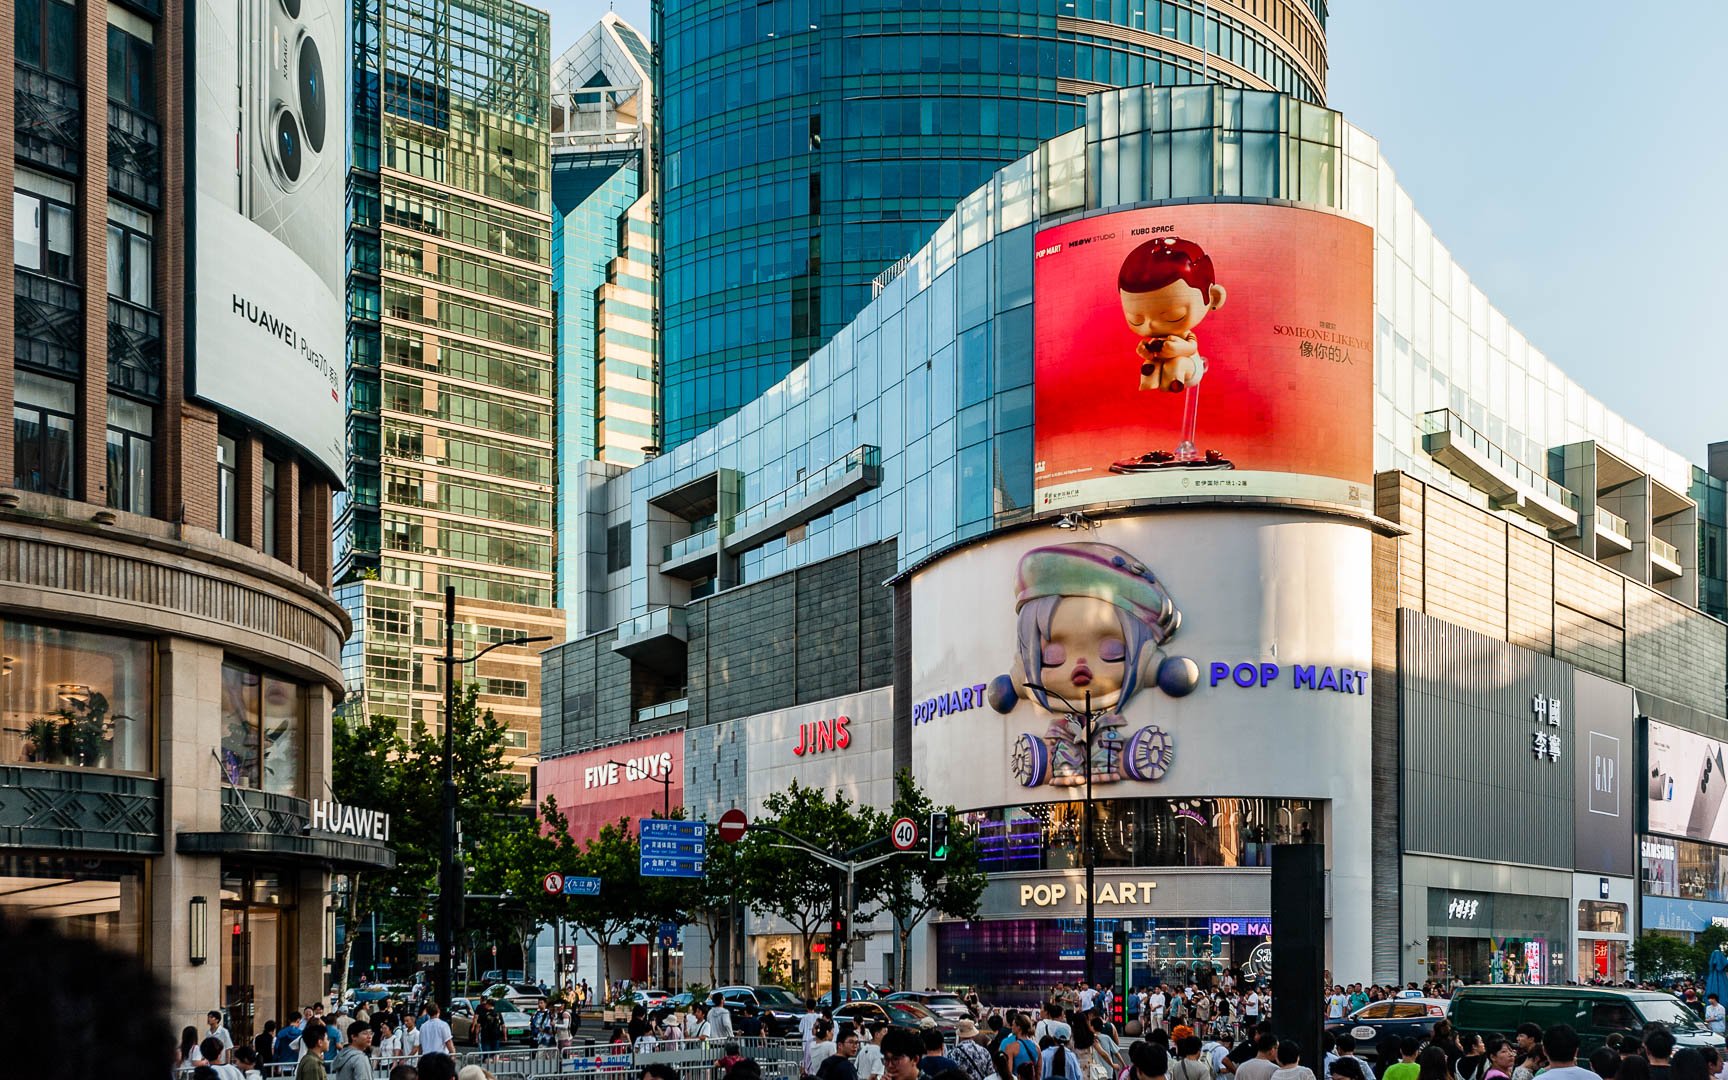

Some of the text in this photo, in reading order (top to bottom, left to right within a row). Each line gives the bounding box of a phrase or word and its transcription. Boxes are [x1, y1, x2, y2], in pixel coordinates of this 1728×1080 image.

[1092, 233, 1116, 243] STUDIO
[1131, 225, 1175, 236] KUBO SPACE
[1036, 244, 1062, 259] POP MART
[232, 294, 297, 350] HUAWEI
[1273, 325, 1330, 342] SOMEONE
[1331, 332, 1355, 348] LIKE
[1300, 340, 1354, 366] 像你的人
[1210, 662, 1369, 696] POP MART
[913, 684, 987, 727] POP MART
[585, 752, 672, 790] FIVE GUYS
[1595, 754, 1614, 794] GAP
[313, 798, 390, 842] HUAWEI
[897, 825, 913, 842] 40
[1642, 841, 1675, 861] SAMSUNG
[1020, 882, 1157, 906] POP MART
[1212, 923, 1272, 936] POP MA
